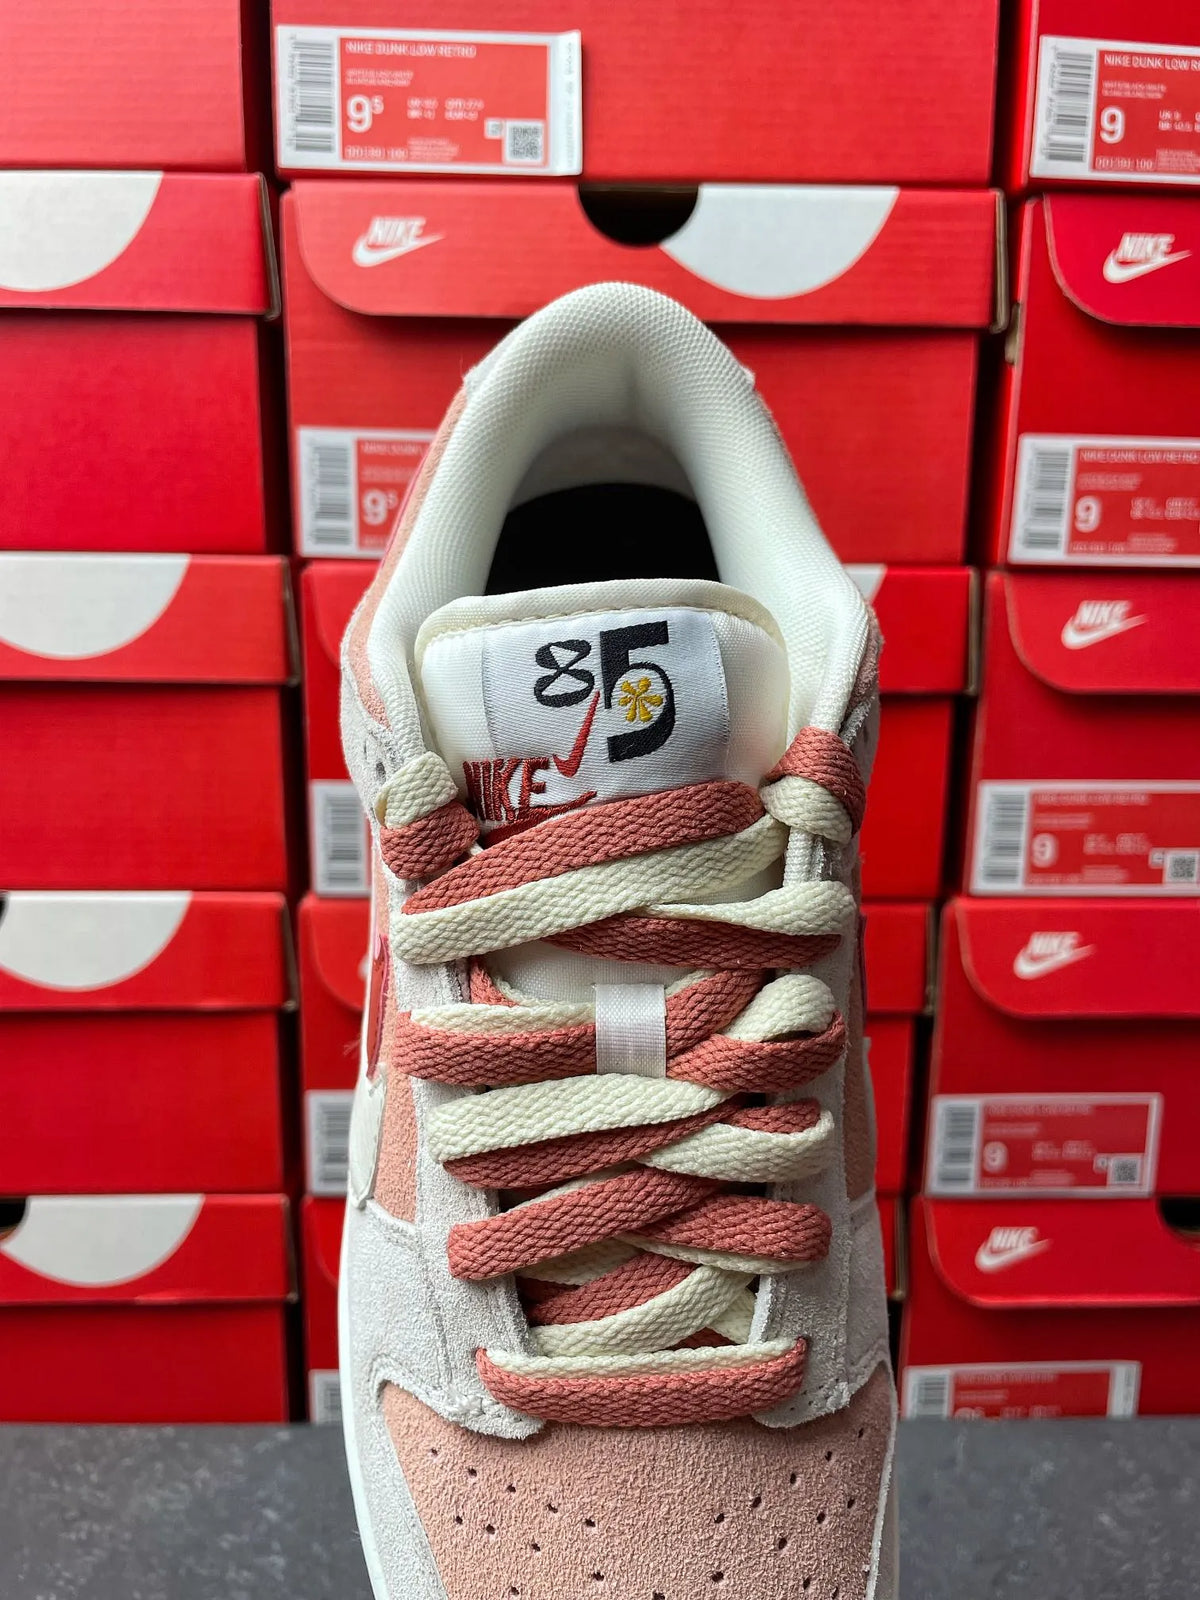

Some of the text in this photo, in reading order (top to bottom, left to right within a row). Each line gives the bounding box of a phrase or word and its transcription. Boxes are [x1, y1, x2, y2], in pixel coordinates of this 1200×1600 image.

[345, 41, 373, 55] NIKE
[1104, 54, 1131, 67] NIKE
[1132, 55, 1164, 69] DUNK
[1165, 58, 1190, 70] LOW
[1100, 106, 1126, 144] 9
[367, 215, 427, 247] NIKE
[1115, 232, 1176, 262] NIKE
[1075, 495, 1101, 533] 9
[1073, 600, 1132, 626] NIKE
[462, 756, 550, 824] NIKE
[1025, 931, 1081, 955] NIKE
[985, 1226, 1039, 1250] NIKE
